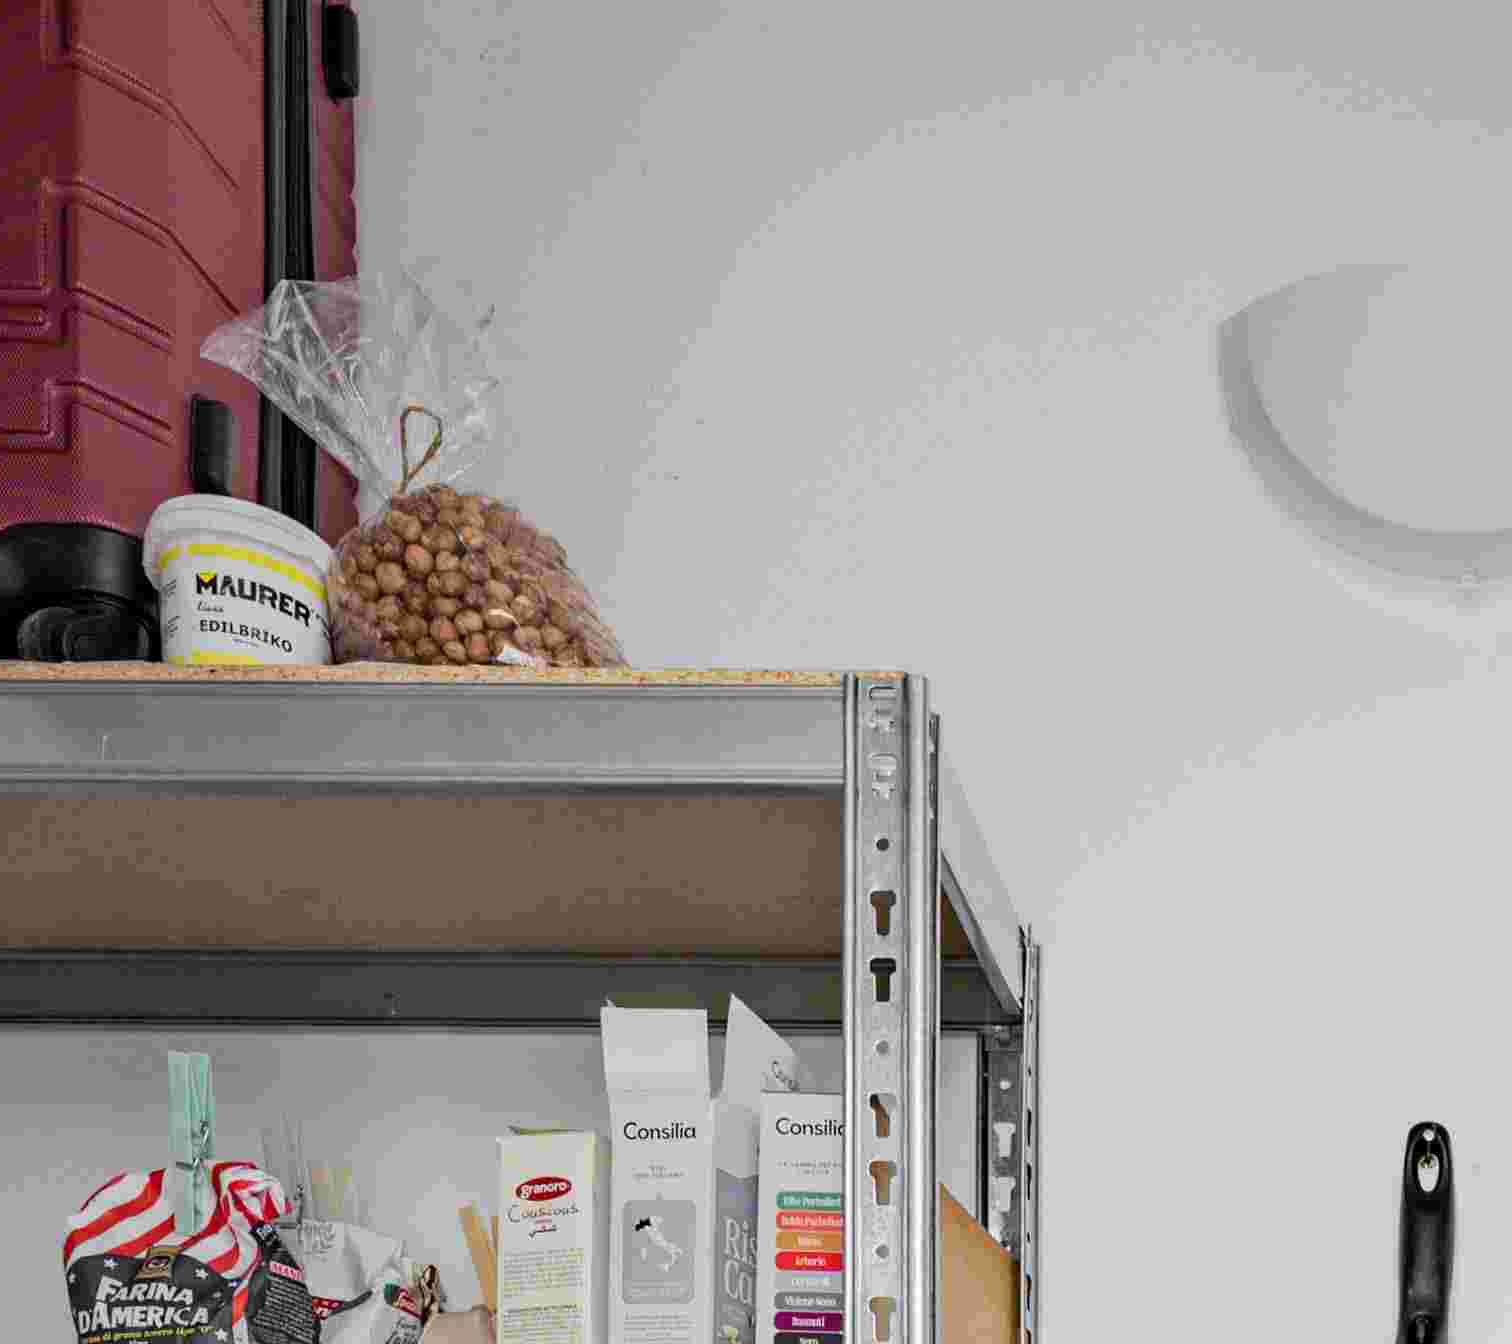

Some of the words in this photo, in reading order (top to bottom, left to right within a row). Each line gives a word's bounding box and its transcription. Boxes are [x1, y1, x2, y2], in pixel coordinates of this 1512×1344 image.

[195, 570, 311, 627] MAURER
[199, 619, 293, 653] EDILBRIKO
[623, 1120, 697, 1142] Consilia
[521, 1180, 568, 1199] granoro
[95, 1275, 194, 1304] FARINA
